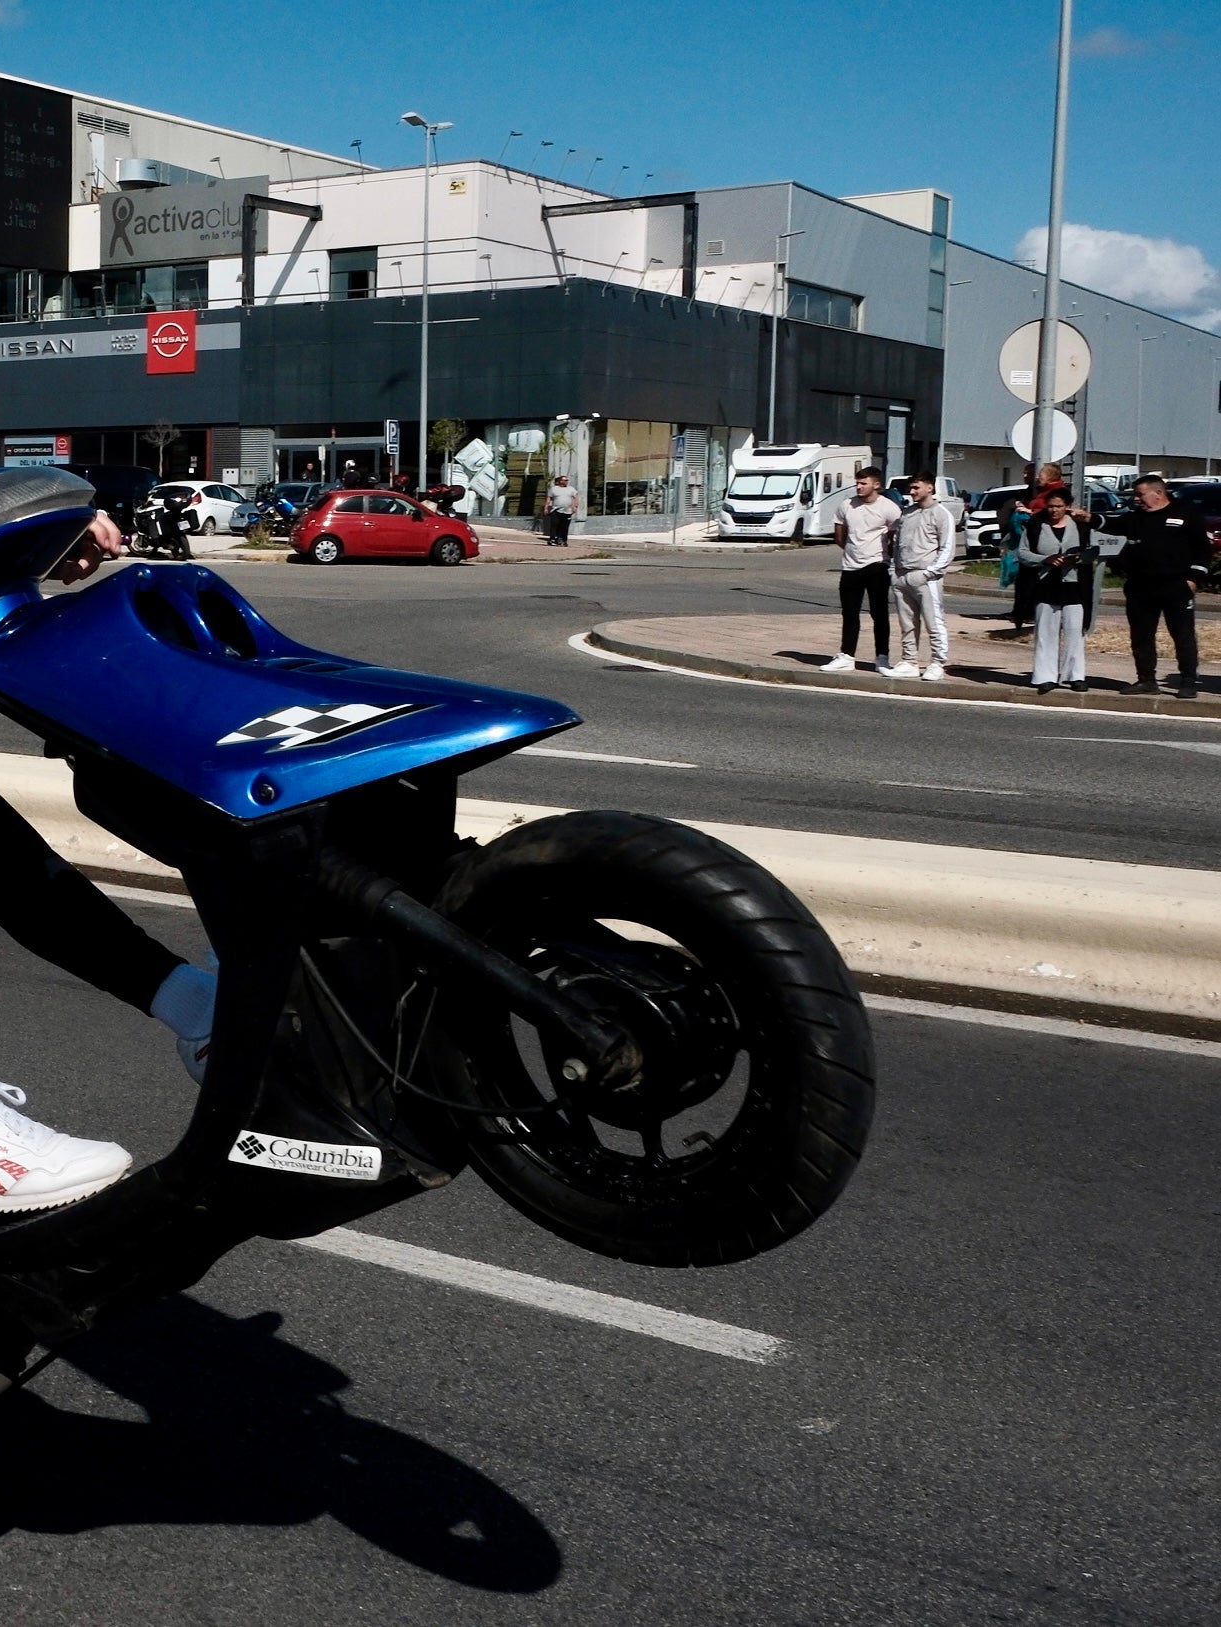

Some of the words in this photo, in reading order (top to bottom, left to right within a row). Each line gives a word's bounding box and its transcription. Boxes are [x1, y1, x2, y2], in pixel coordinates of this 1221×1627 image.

[134, 201, 260, 235] activaclu
[151, 336, 190, 344] NISSAN
[267, 1156, 322, 1172] Sportswear
[269, 1139, 374, 1169] Columbia
